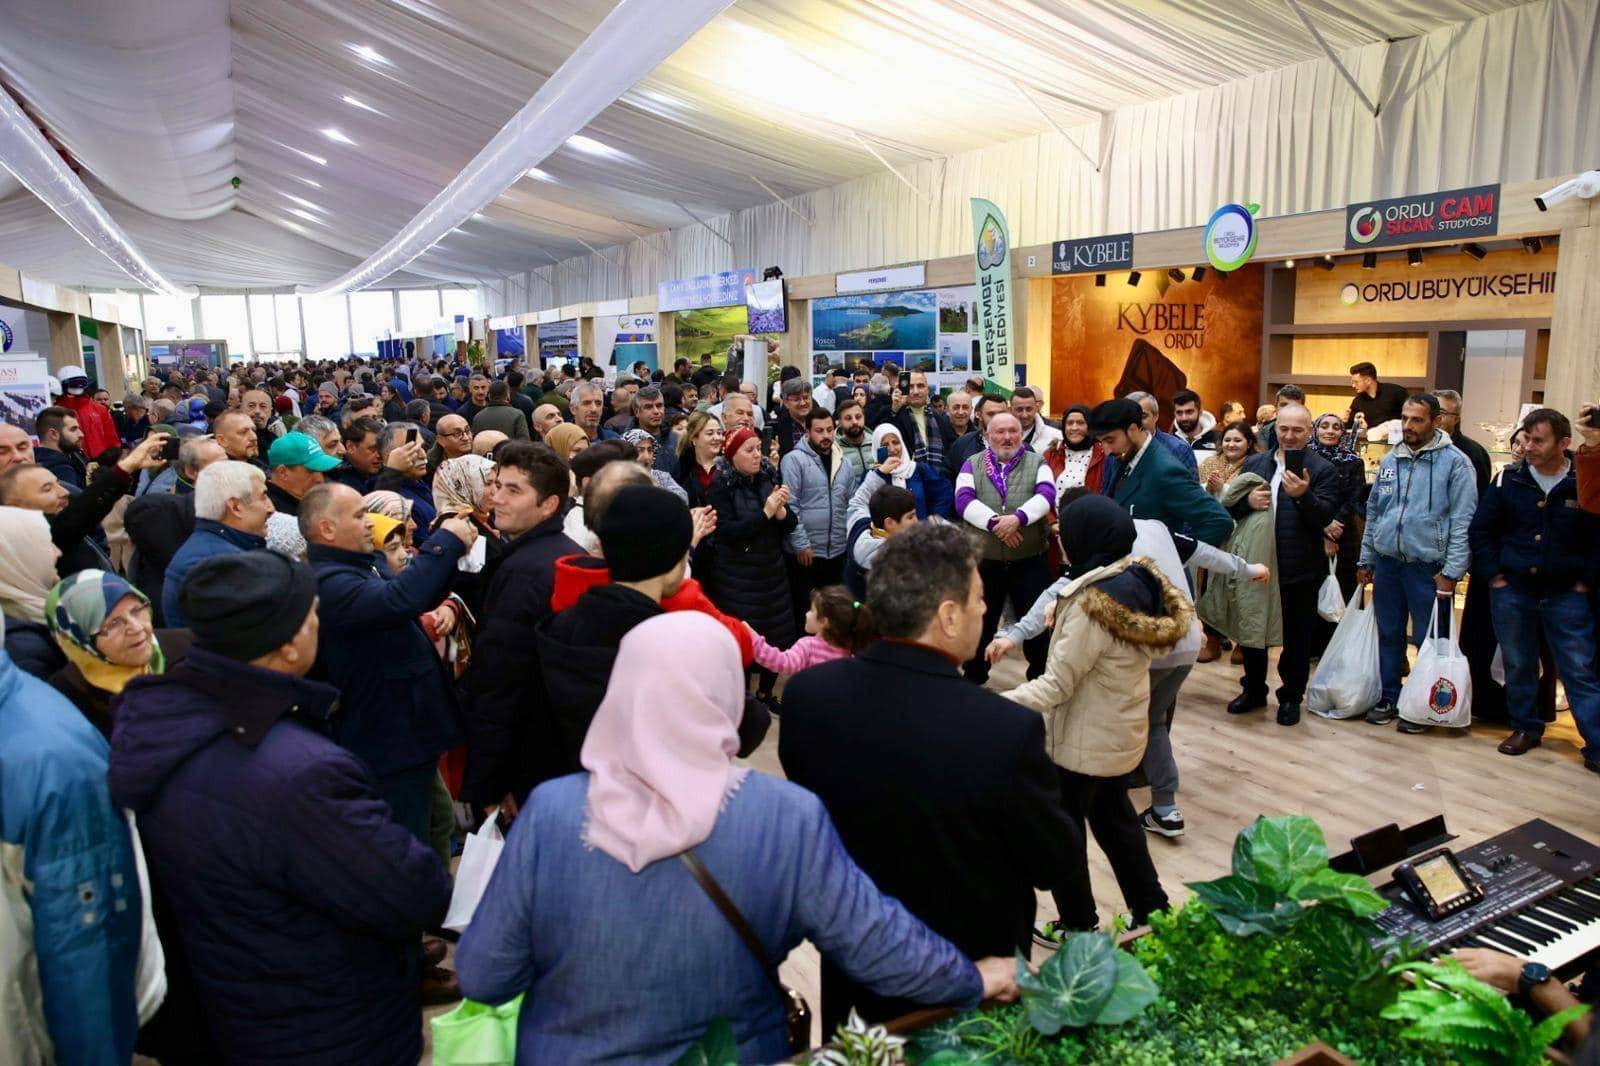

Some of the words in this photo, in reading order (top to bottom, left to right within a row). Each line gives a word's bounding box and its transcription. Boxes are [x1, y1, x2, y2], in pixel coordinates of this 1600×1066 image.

[1386, 201, 1434, 221] ORDU
[1440, 193, 1495, 220] CAM
[1387, 216, 1435, 237] SICAK
[1073, 240, 1130, 267] KYBELE
[981, 273, 996, 378] PERŞEMBE
[994, 279, 1008, 367] BELEDİYESİ
[1116, 303, 1205, 335] KYBELE
[1164, 333, 1204, 350] ORDU
